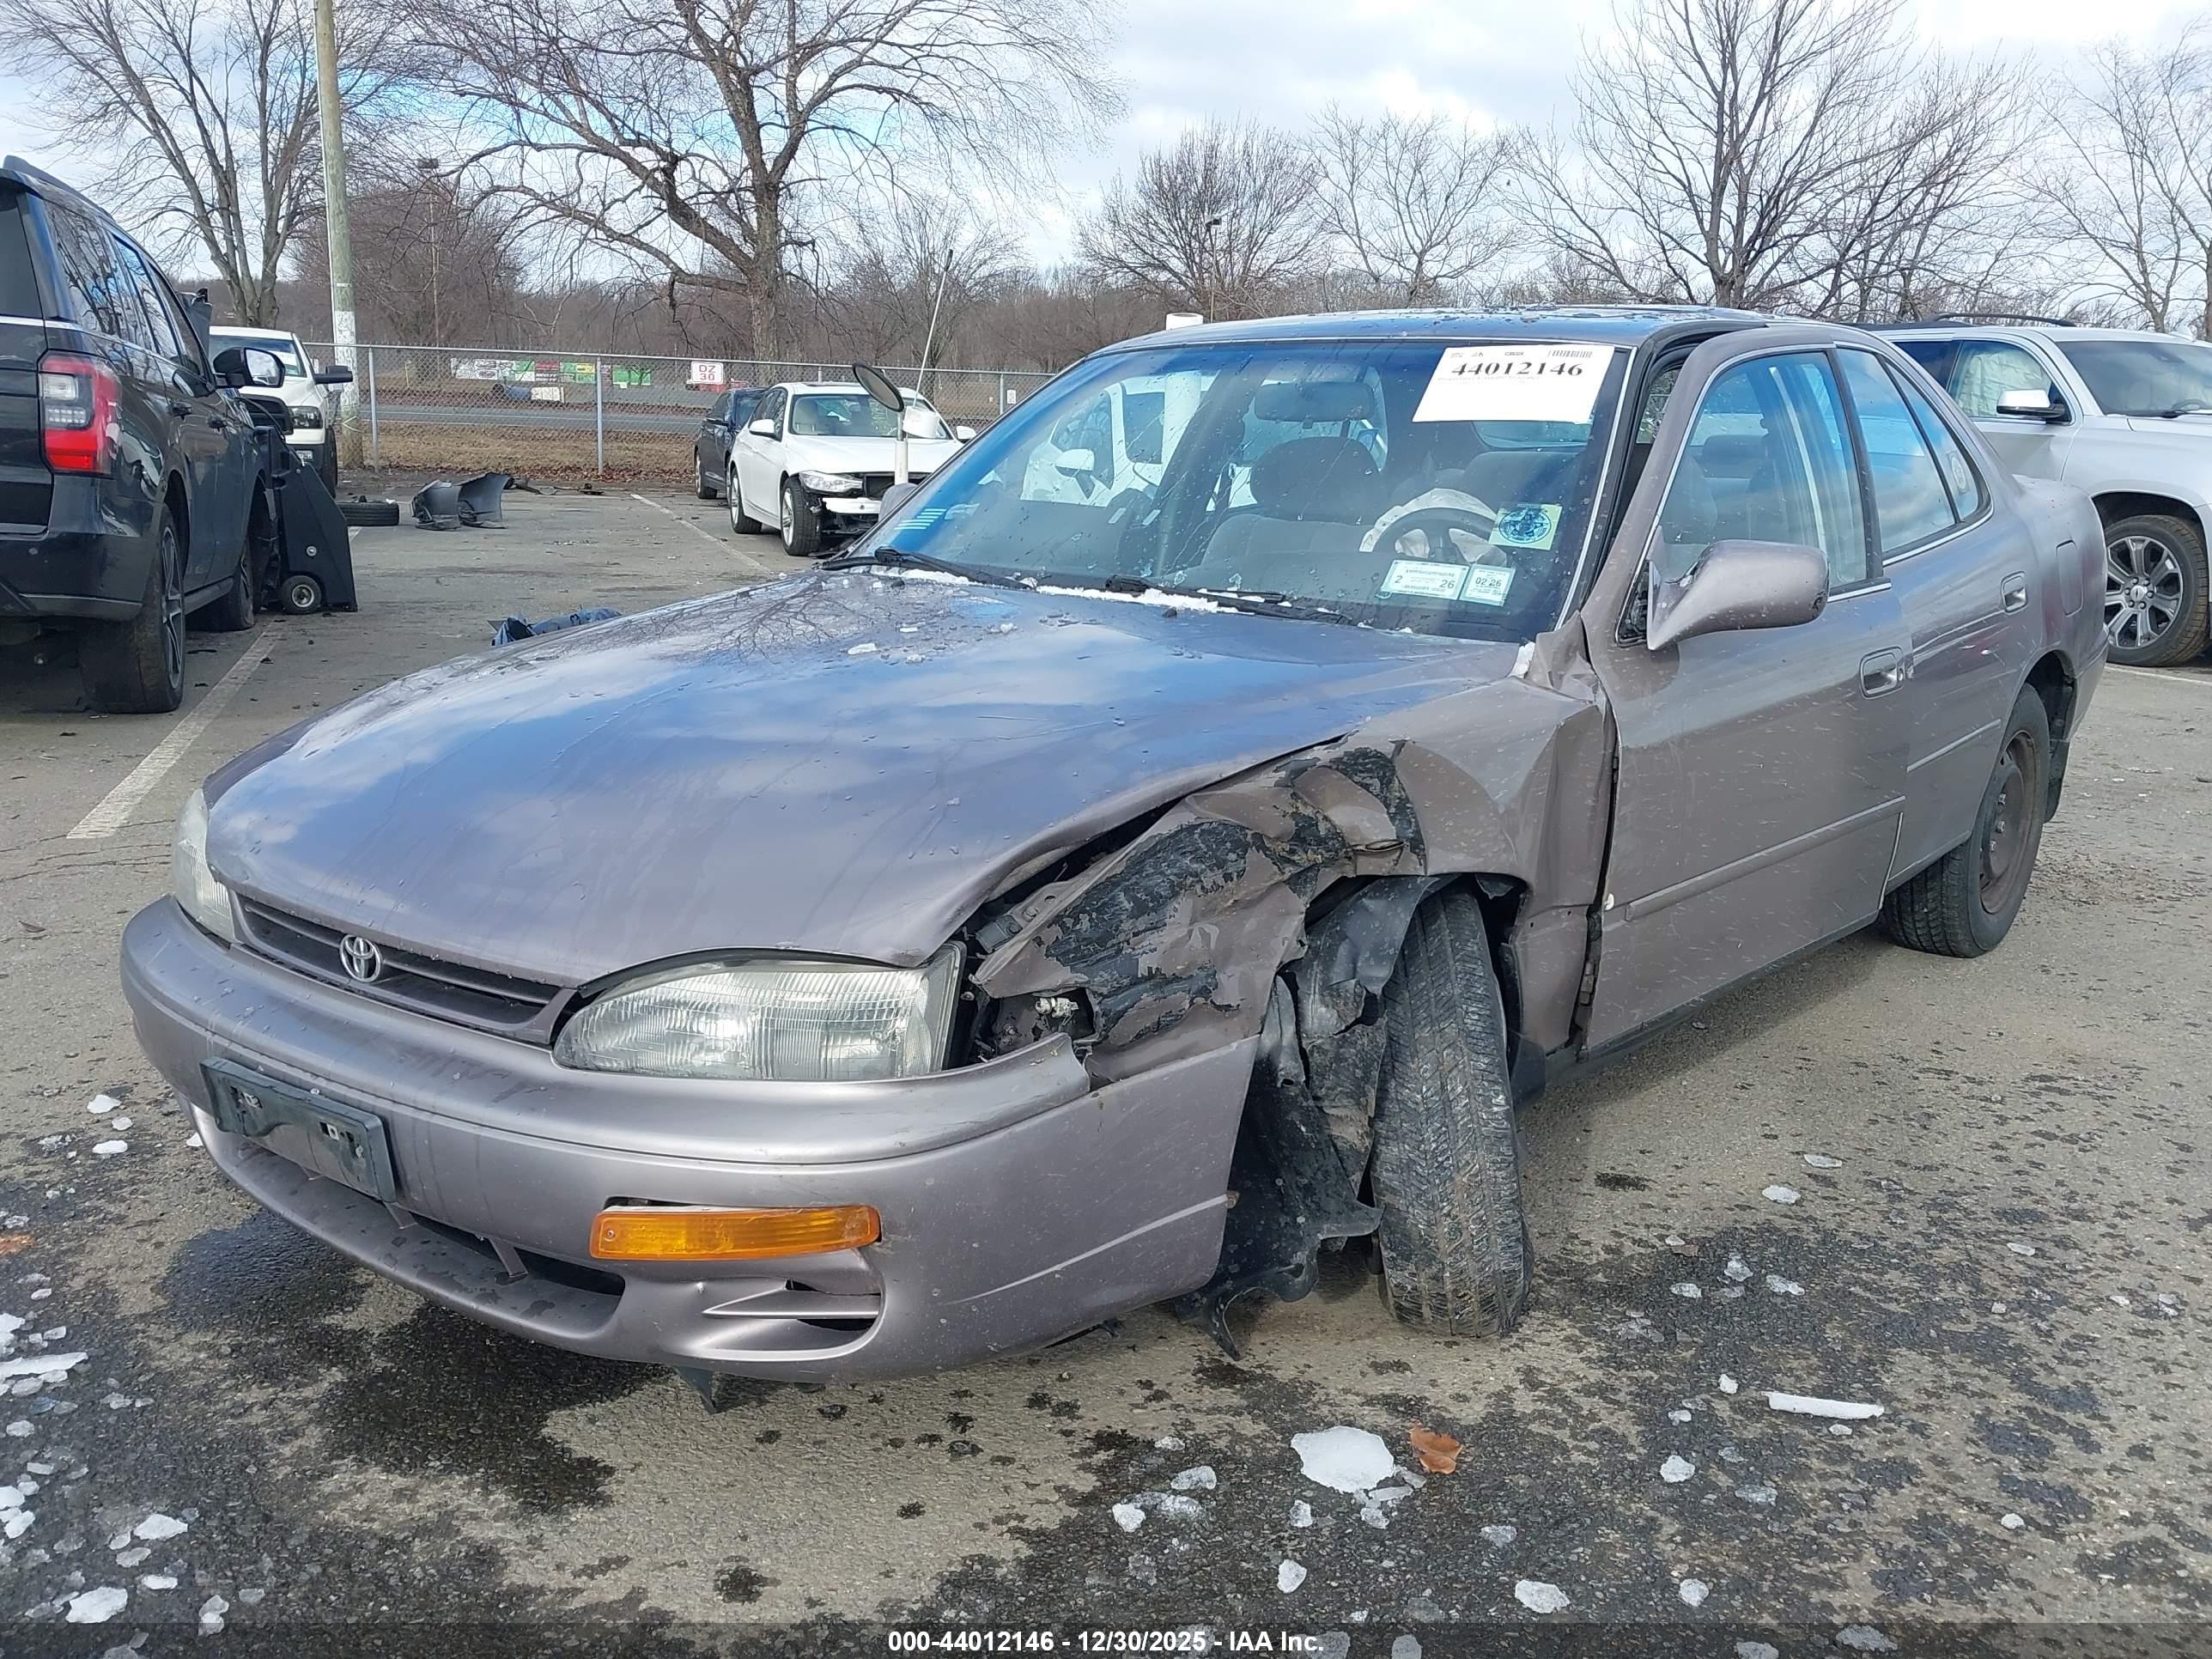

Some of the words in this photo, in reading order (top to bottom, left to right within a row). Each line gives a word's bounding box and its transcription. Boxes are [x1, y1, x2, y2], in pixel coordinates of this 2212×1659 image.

[699, 364, 715, 373] DZ
[1451, 362, 1583, 375] 44012146
[1394, 574, 1403, 584] 2
[1439, 579, 1455, 589] 26
